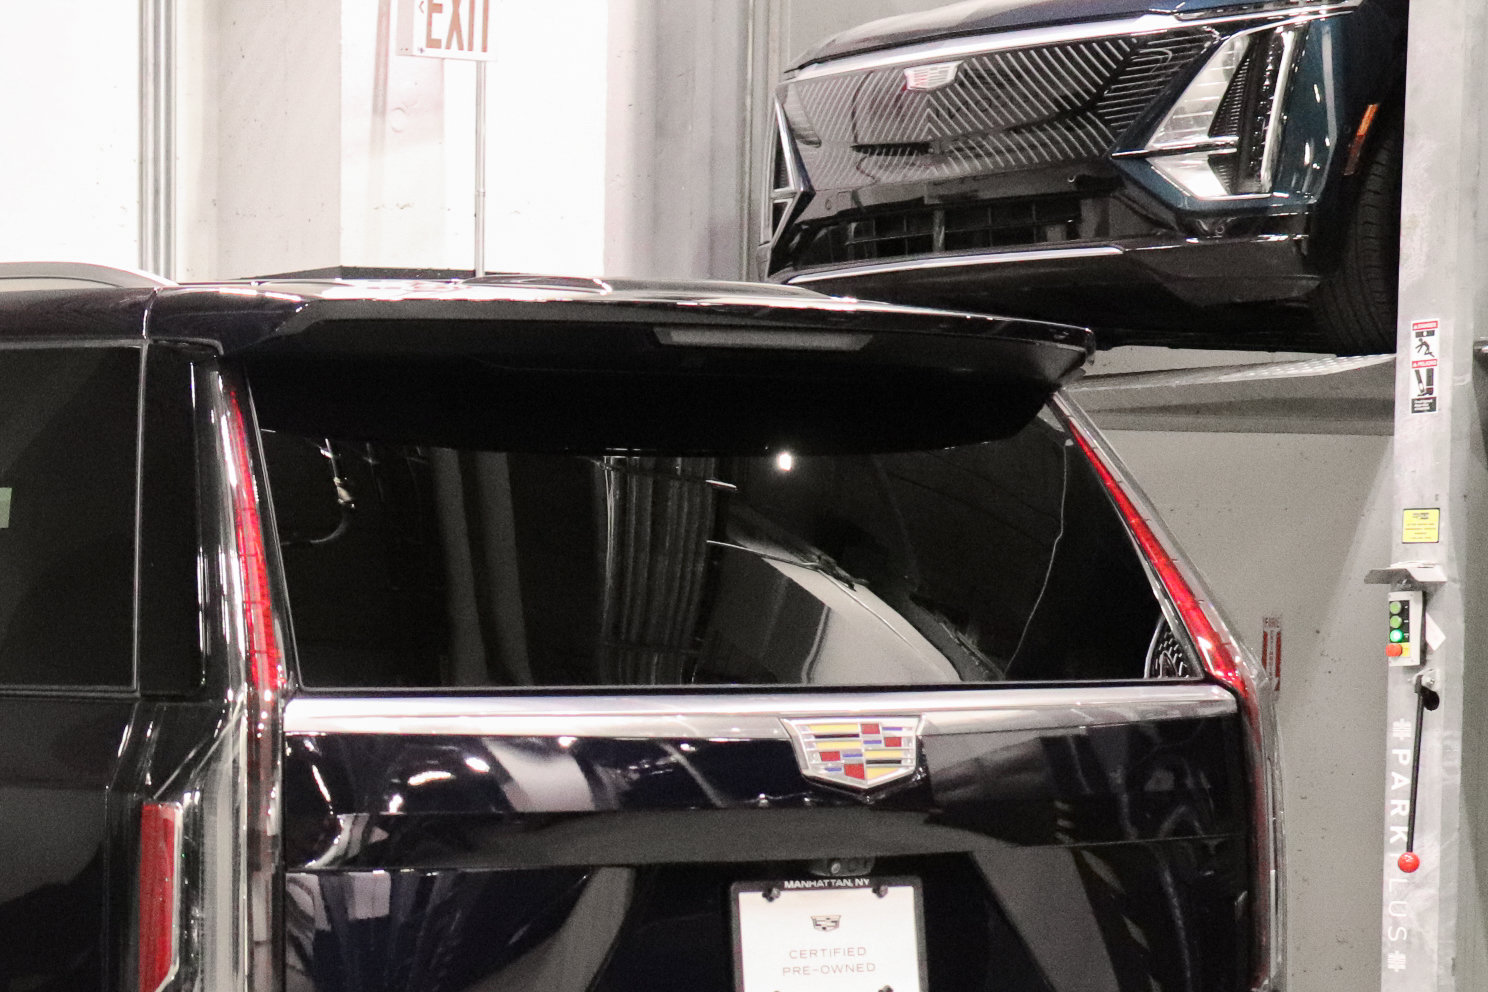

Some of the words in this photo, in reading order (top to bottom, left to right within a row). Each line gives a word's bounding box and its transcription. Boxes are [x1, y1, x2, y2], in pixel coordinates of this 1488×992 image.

[784, 879, 853, 889] MANHATTAN,
[855, 878, 870, 887] NY
[789, 946, 867, 959] CERTIFIED
[782, 962, 876, 976] PRE-OWNED
